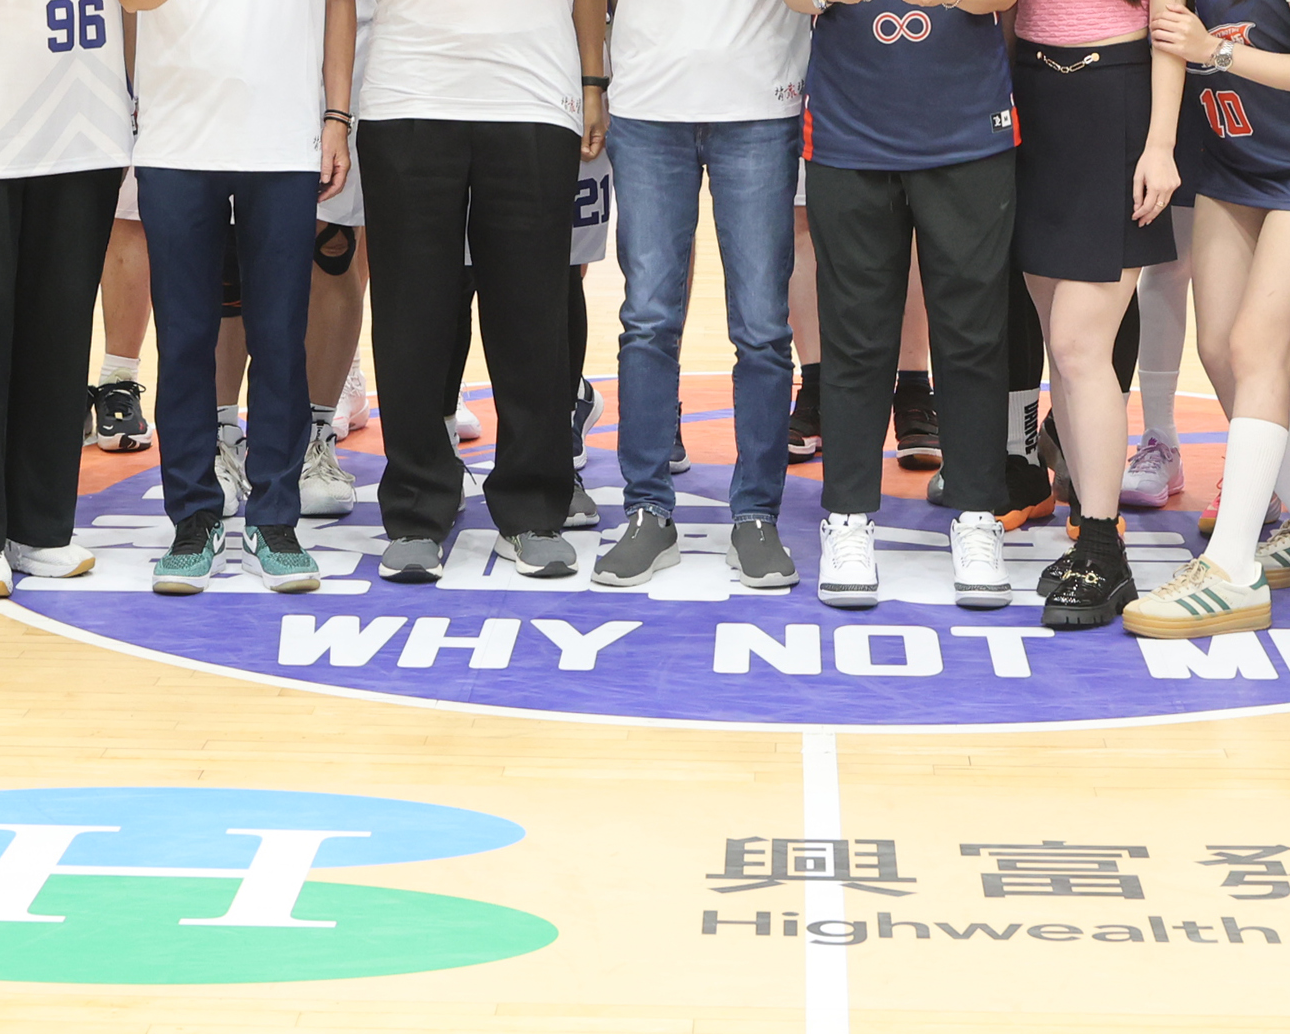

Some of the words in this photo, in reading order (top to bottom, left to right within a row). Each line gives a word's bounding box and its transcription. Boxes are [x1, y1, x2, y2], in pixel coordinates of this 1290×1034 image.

[1199, 88, 1255, 140] 10
[573, 173, 610, 229] 21
[277, 614, 646, 673] WHY
[710, 621, 1056, 678] NOT
[701, 908, 1282, 947] Highwealth
